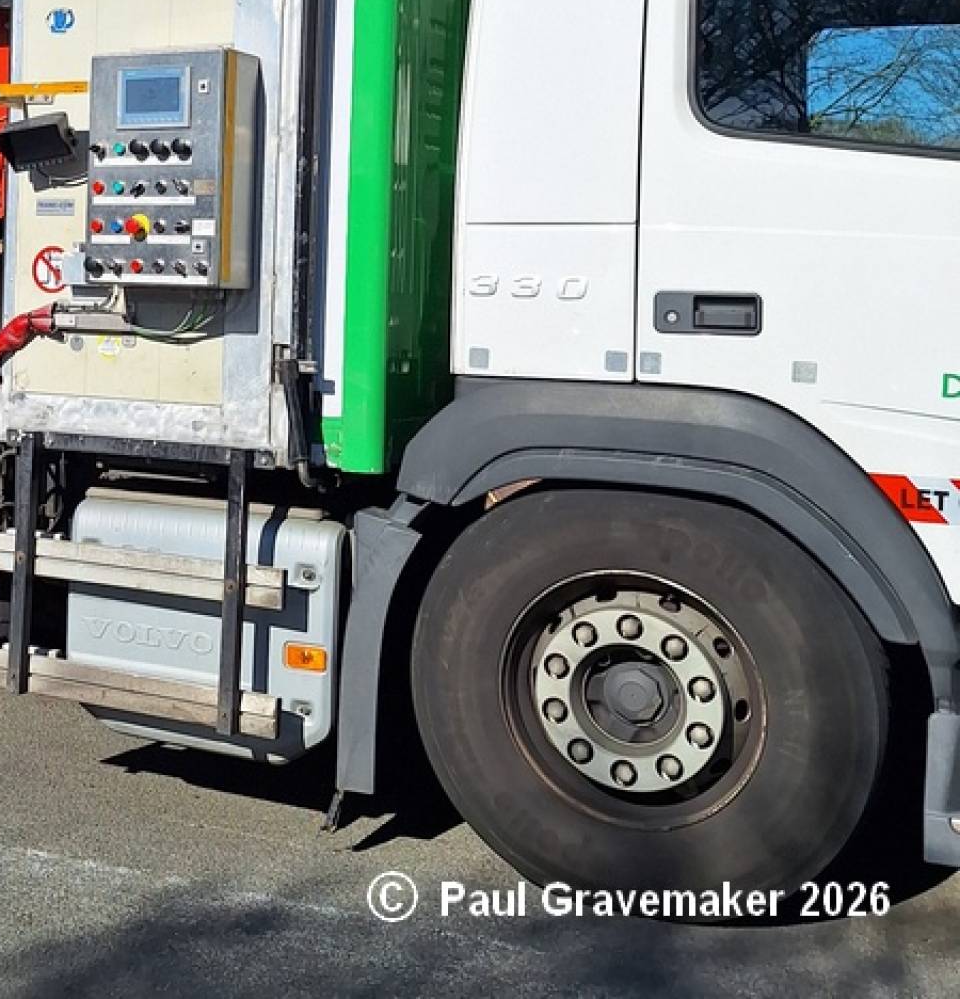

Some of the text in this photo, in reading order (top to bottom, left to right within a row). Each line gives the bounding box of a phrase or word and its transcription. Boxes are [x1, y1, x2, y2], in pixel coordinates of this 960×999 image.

[467, 272, 589, 301] 330
[900, 488, 950, 512] LET
[81, 614, 214, 657] VOLVO
